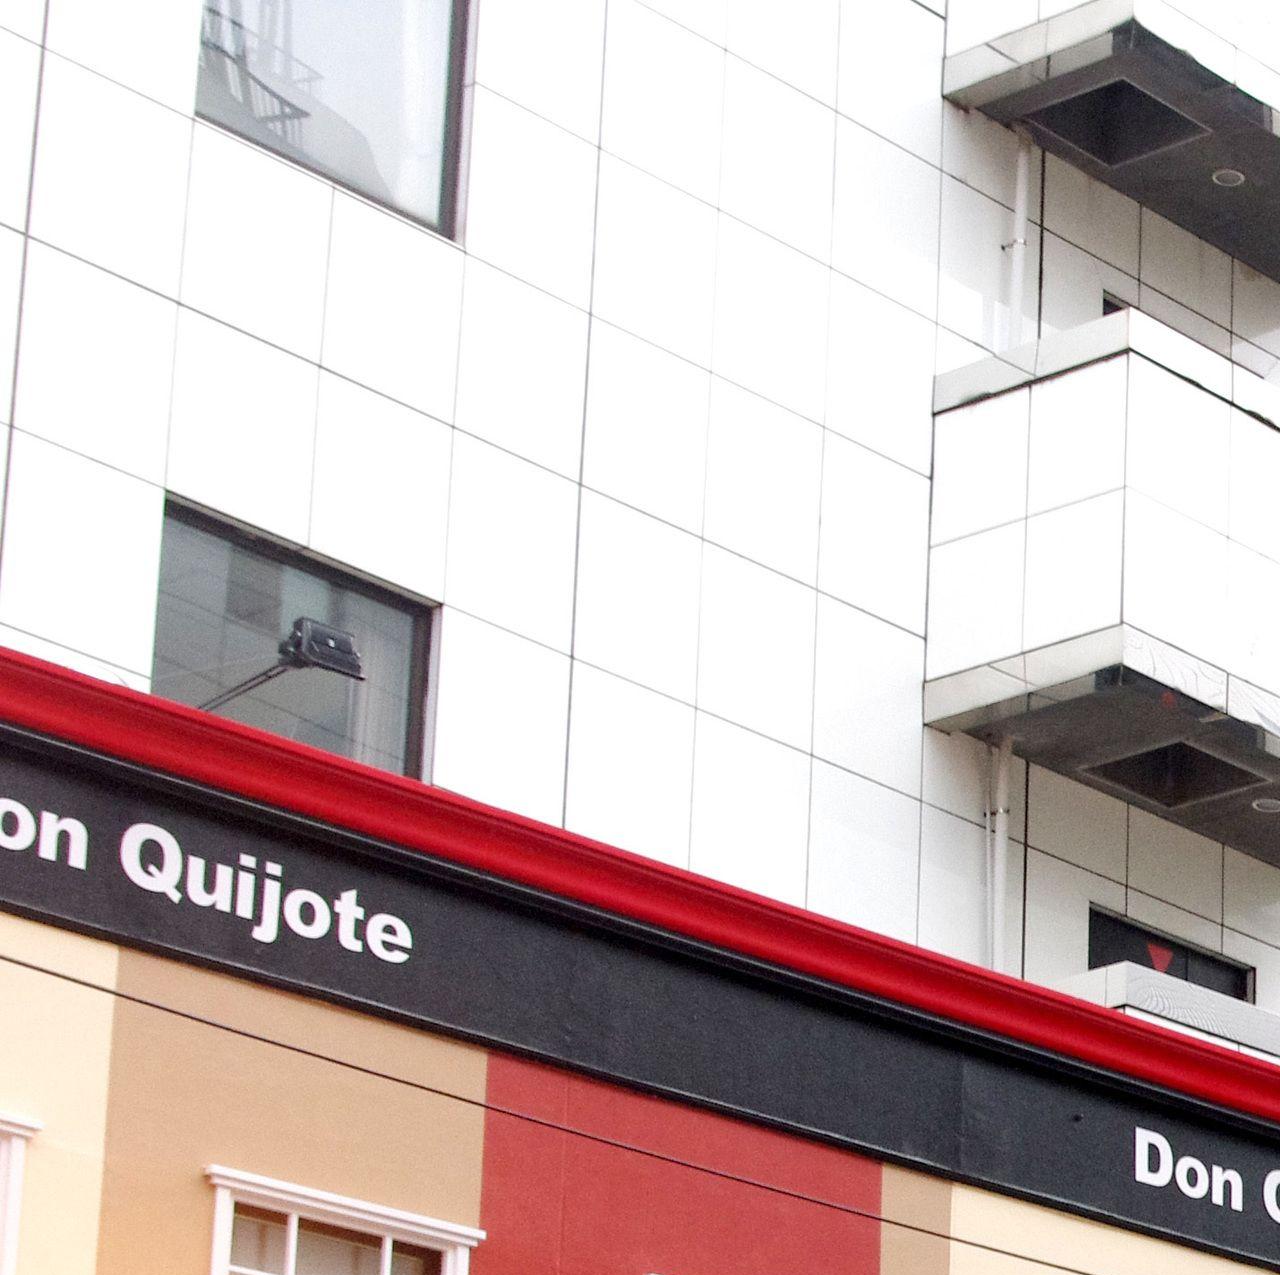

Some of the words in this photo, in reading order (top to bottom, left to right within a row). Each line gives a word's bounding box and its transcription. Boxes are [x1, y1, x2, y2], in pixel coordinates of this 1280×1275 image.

[0, 796, 88, 871] on
[119, 821, 414, 965] Quijote
[1134, 1126, 1243, 1212] Don
